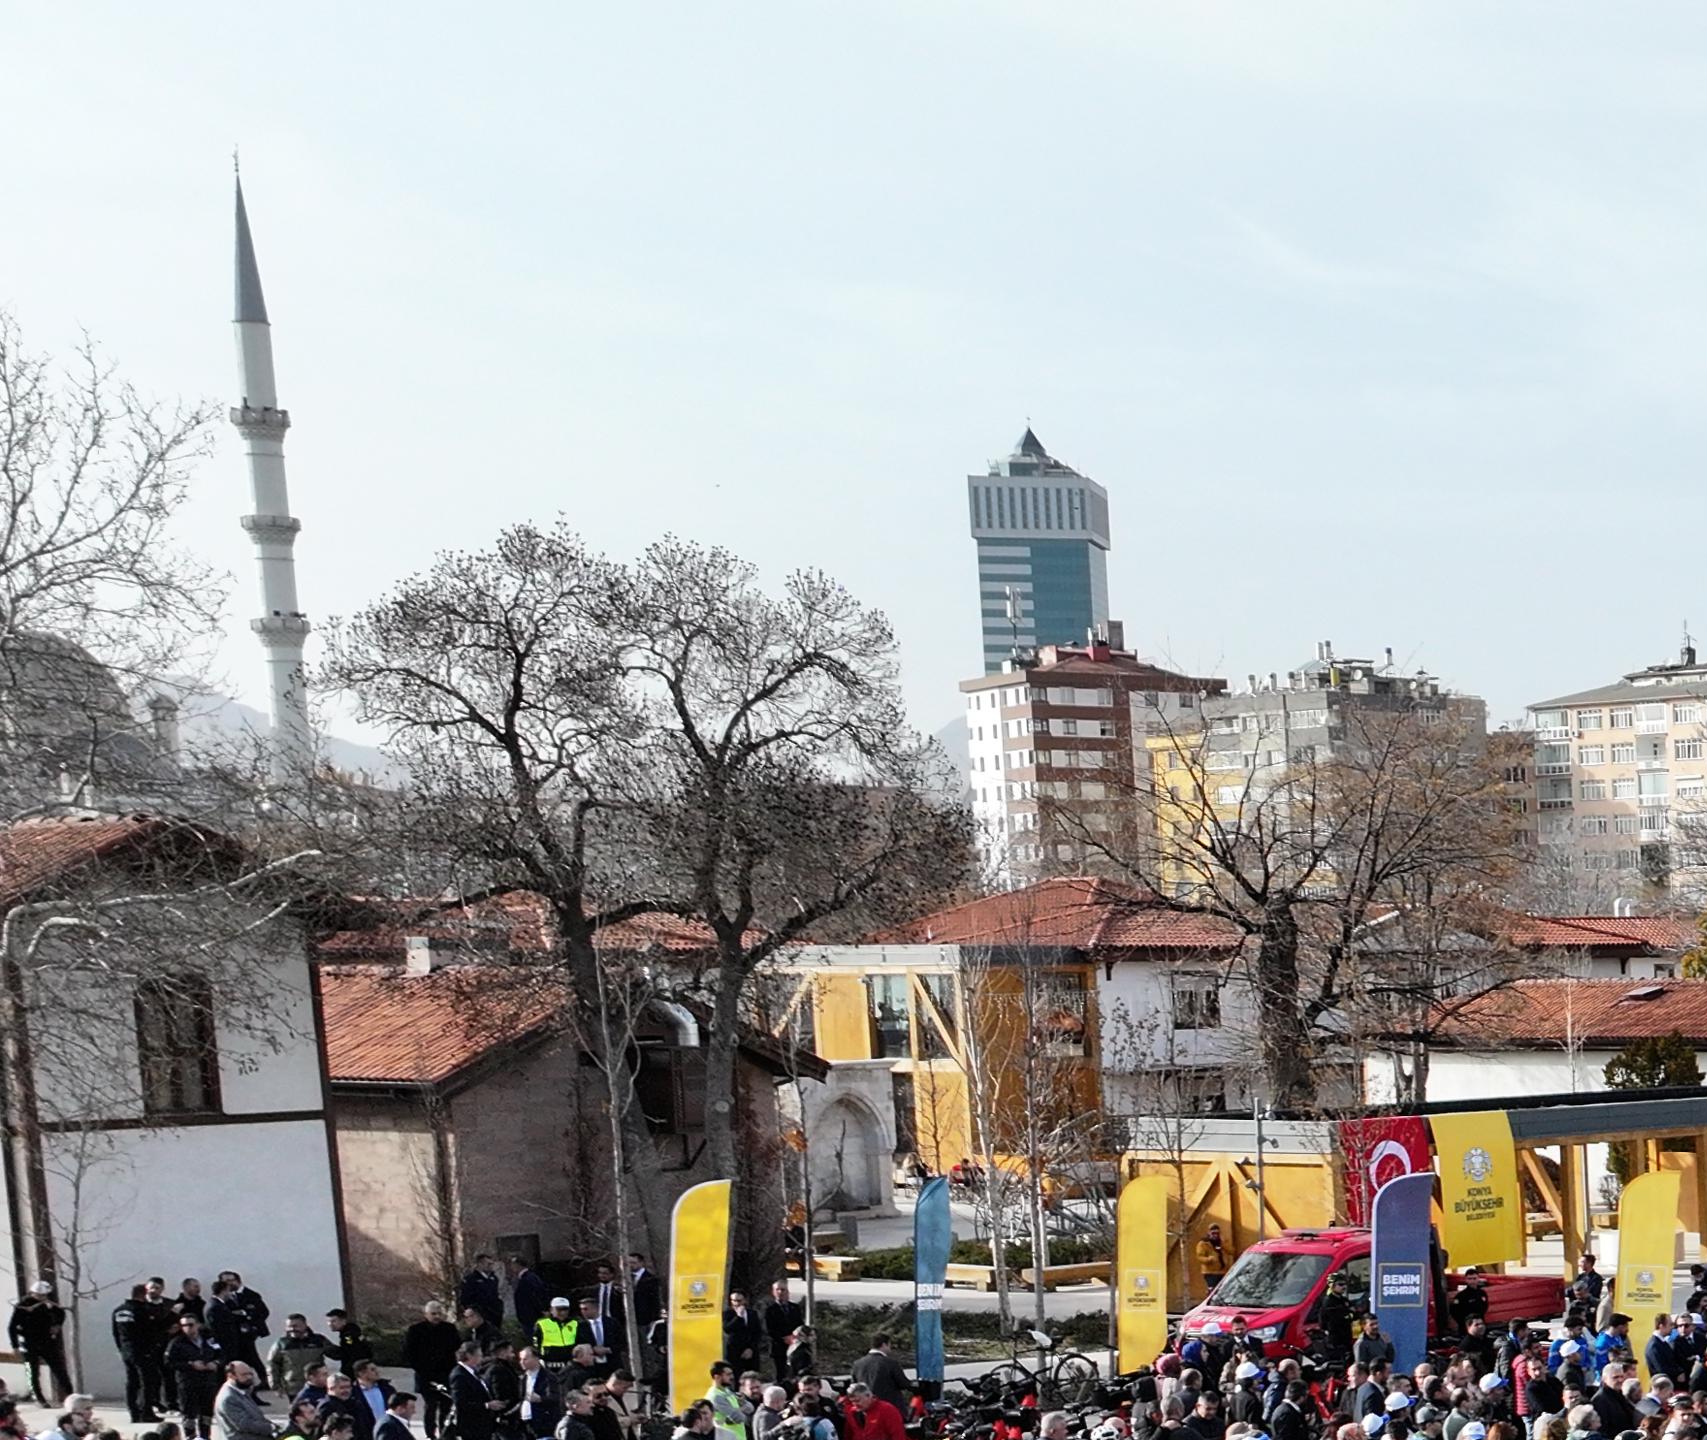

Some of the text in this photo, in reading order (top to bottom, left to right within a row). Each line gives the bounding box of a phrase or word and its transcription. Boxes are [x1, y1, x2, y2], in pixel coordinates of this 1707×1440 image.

[1467, 1186, 1492, 1197] KONYA
[1383, 1274, 1420, 1285] BENİM
[1382, 1285, 1420, 1297] ŞEHRİM
